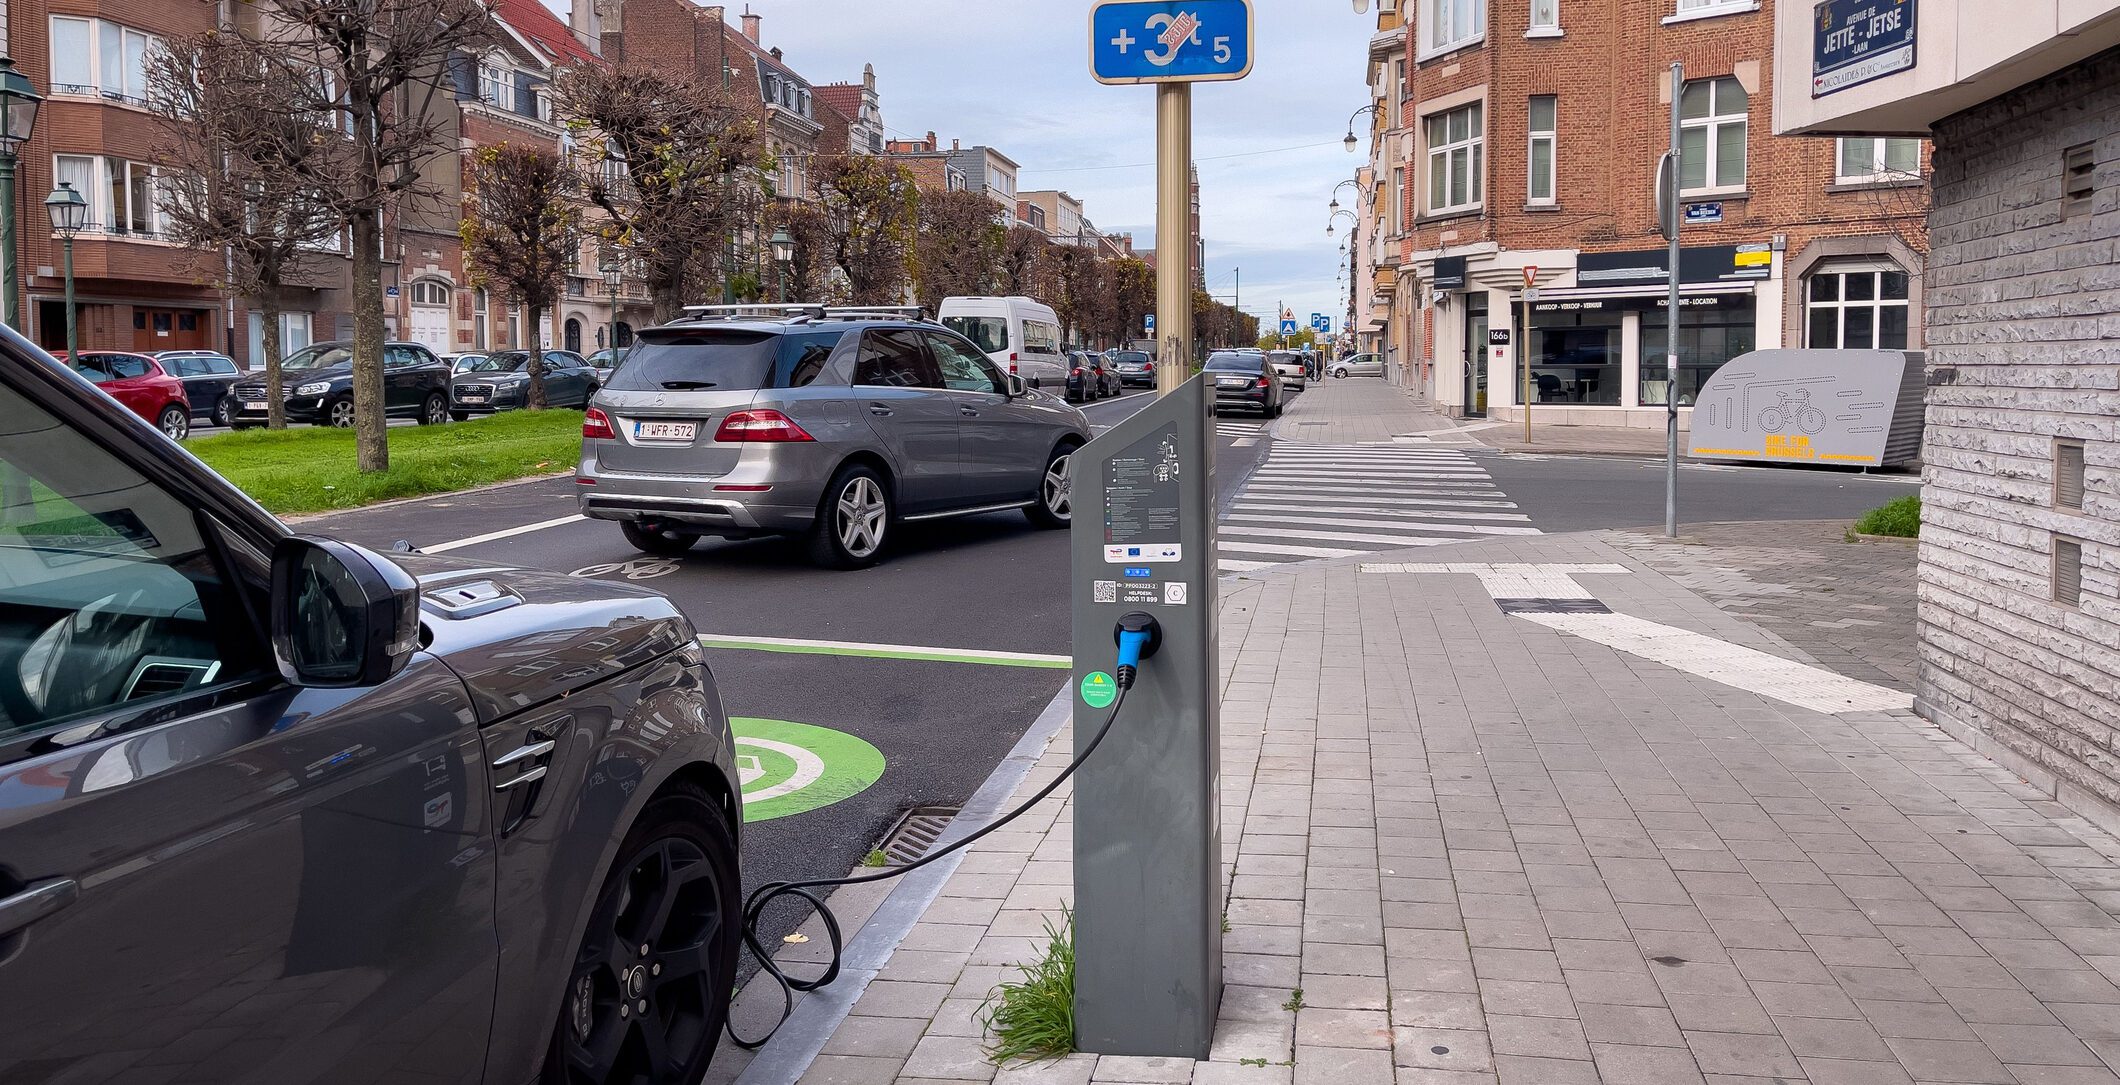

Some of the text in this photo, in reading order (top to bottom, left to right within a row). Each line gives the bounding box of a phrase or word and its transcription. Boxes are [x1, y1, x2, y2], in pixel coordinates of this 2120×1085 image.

[1846, 6, 1876, 26] AVENUE DE
[1824, 25, 1855, 54] JETTE
[1866, 7, 1902, 39] JETSE
[1213, 36, 1232, 64] 5
[1490, 331, 1508, 340] 166b
